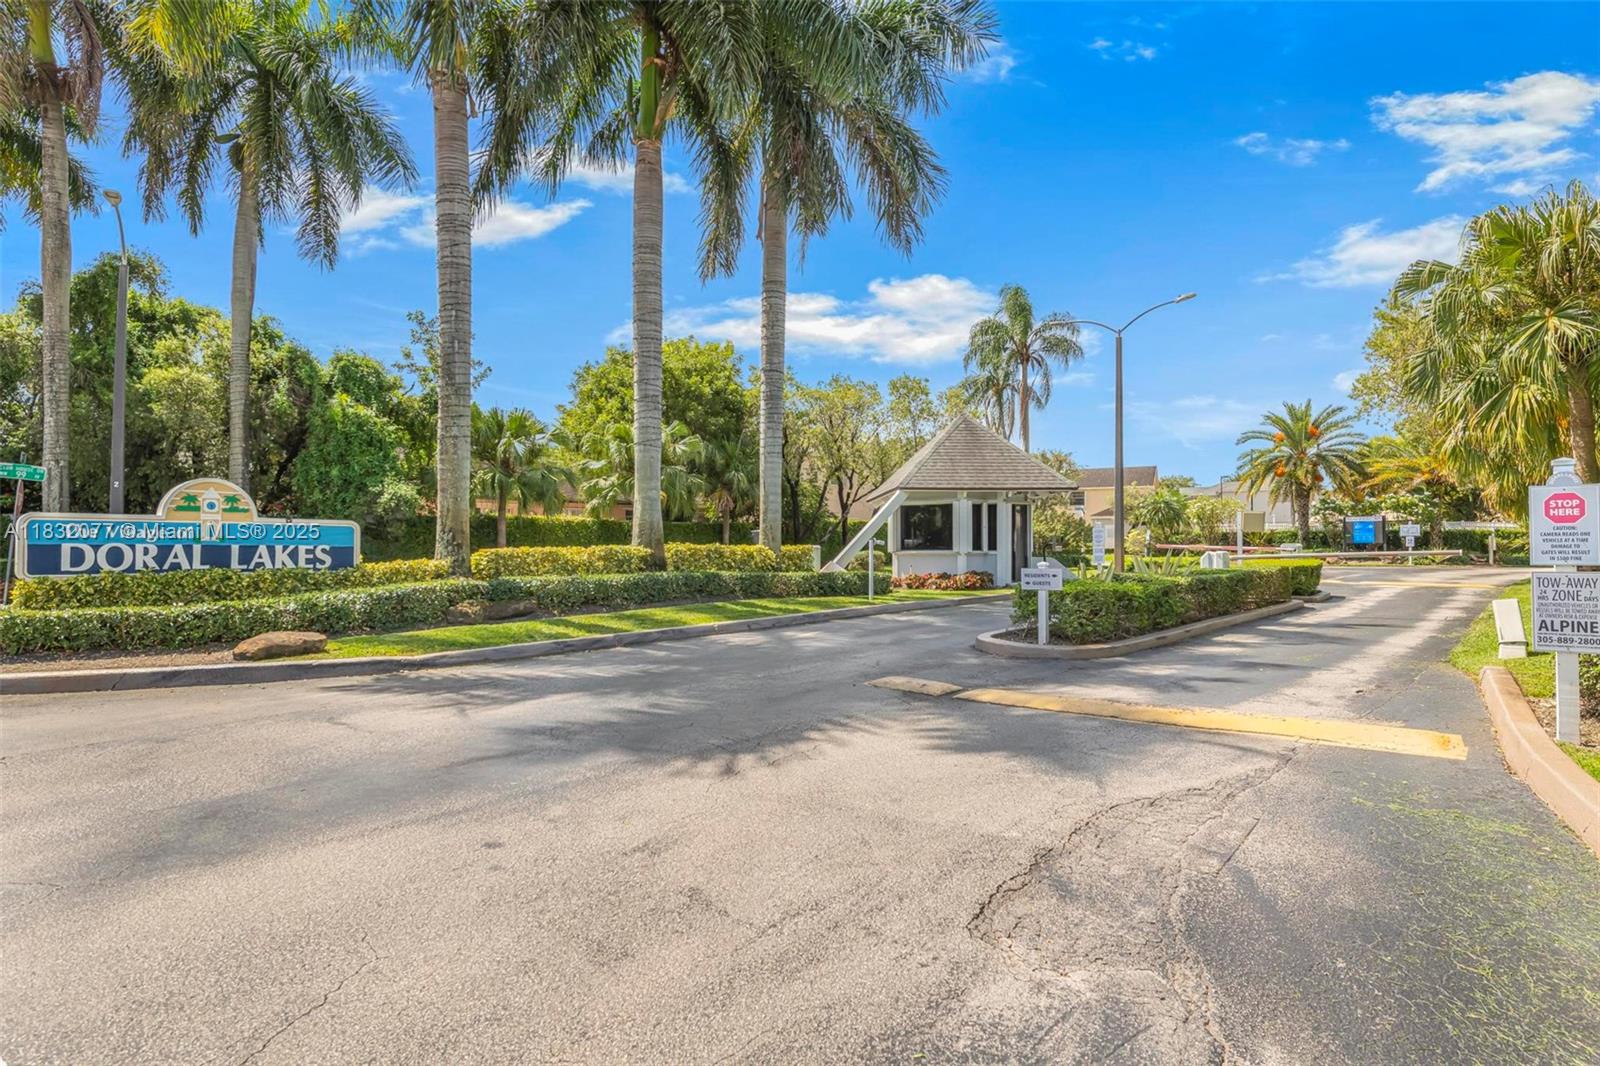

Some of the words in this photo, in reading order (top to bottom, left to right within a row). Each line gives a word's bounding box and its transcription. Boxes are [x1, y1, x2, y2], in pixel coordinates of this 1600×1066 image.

[1549, 499, 1580, 507] STOP
[1550, 508, 1580, 516] HERE
[60, 543, 209, 571] DORAL
[230, 543, 333, 570] LAKES
[1536, 577, 1598, 589] TOW-AWAY
[1552, 590, 1582, 601] ZONE
[1538, 619, 1599, 633] ALPINE
[1537, 636, 1600, 645] 305-889-2800
